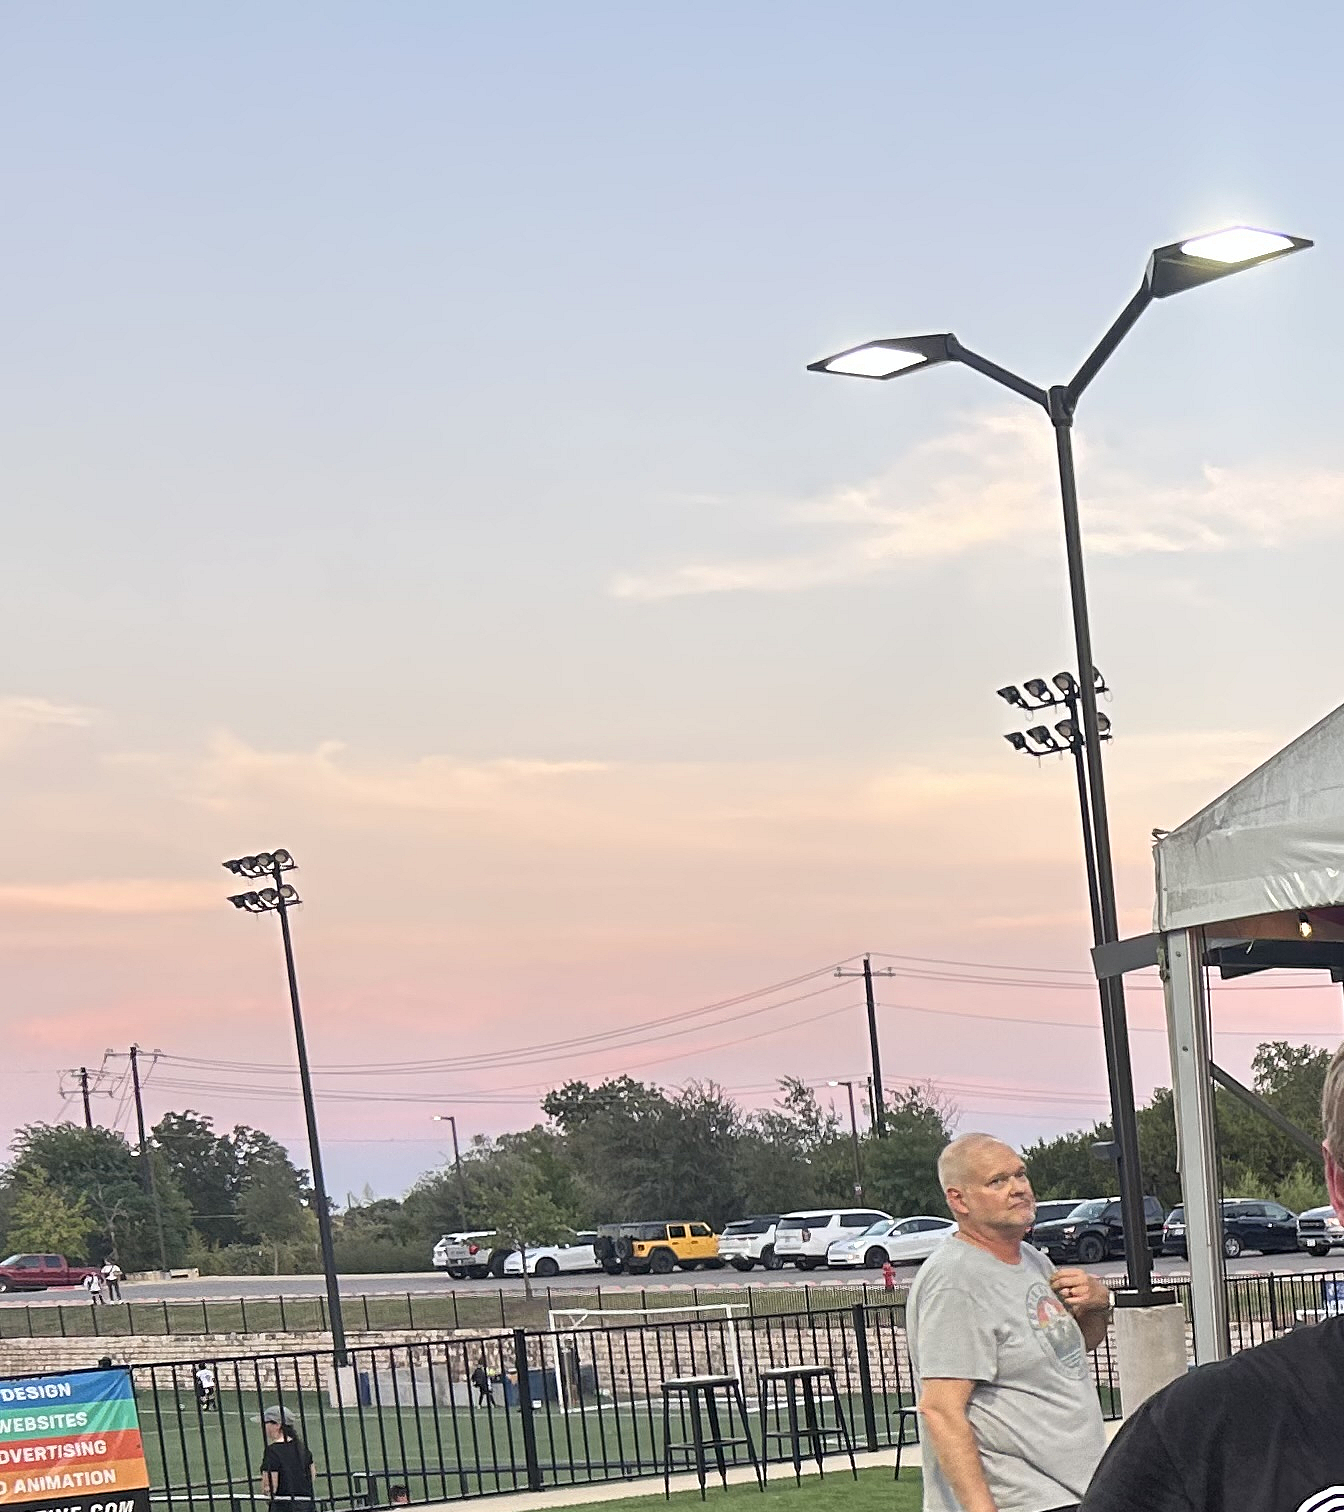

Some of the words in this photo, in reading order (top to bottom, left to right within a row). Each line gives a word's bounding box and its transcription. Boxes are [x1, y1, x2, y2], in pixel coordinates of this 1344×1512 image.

[1, 1383, 71, 1402] DESIGN
[0, 1411, 88, 1433] WEBSITES
[0, 1440, 107, 1465] DVERTISING
[14, 1469, 117, 1494] ANIMATION
